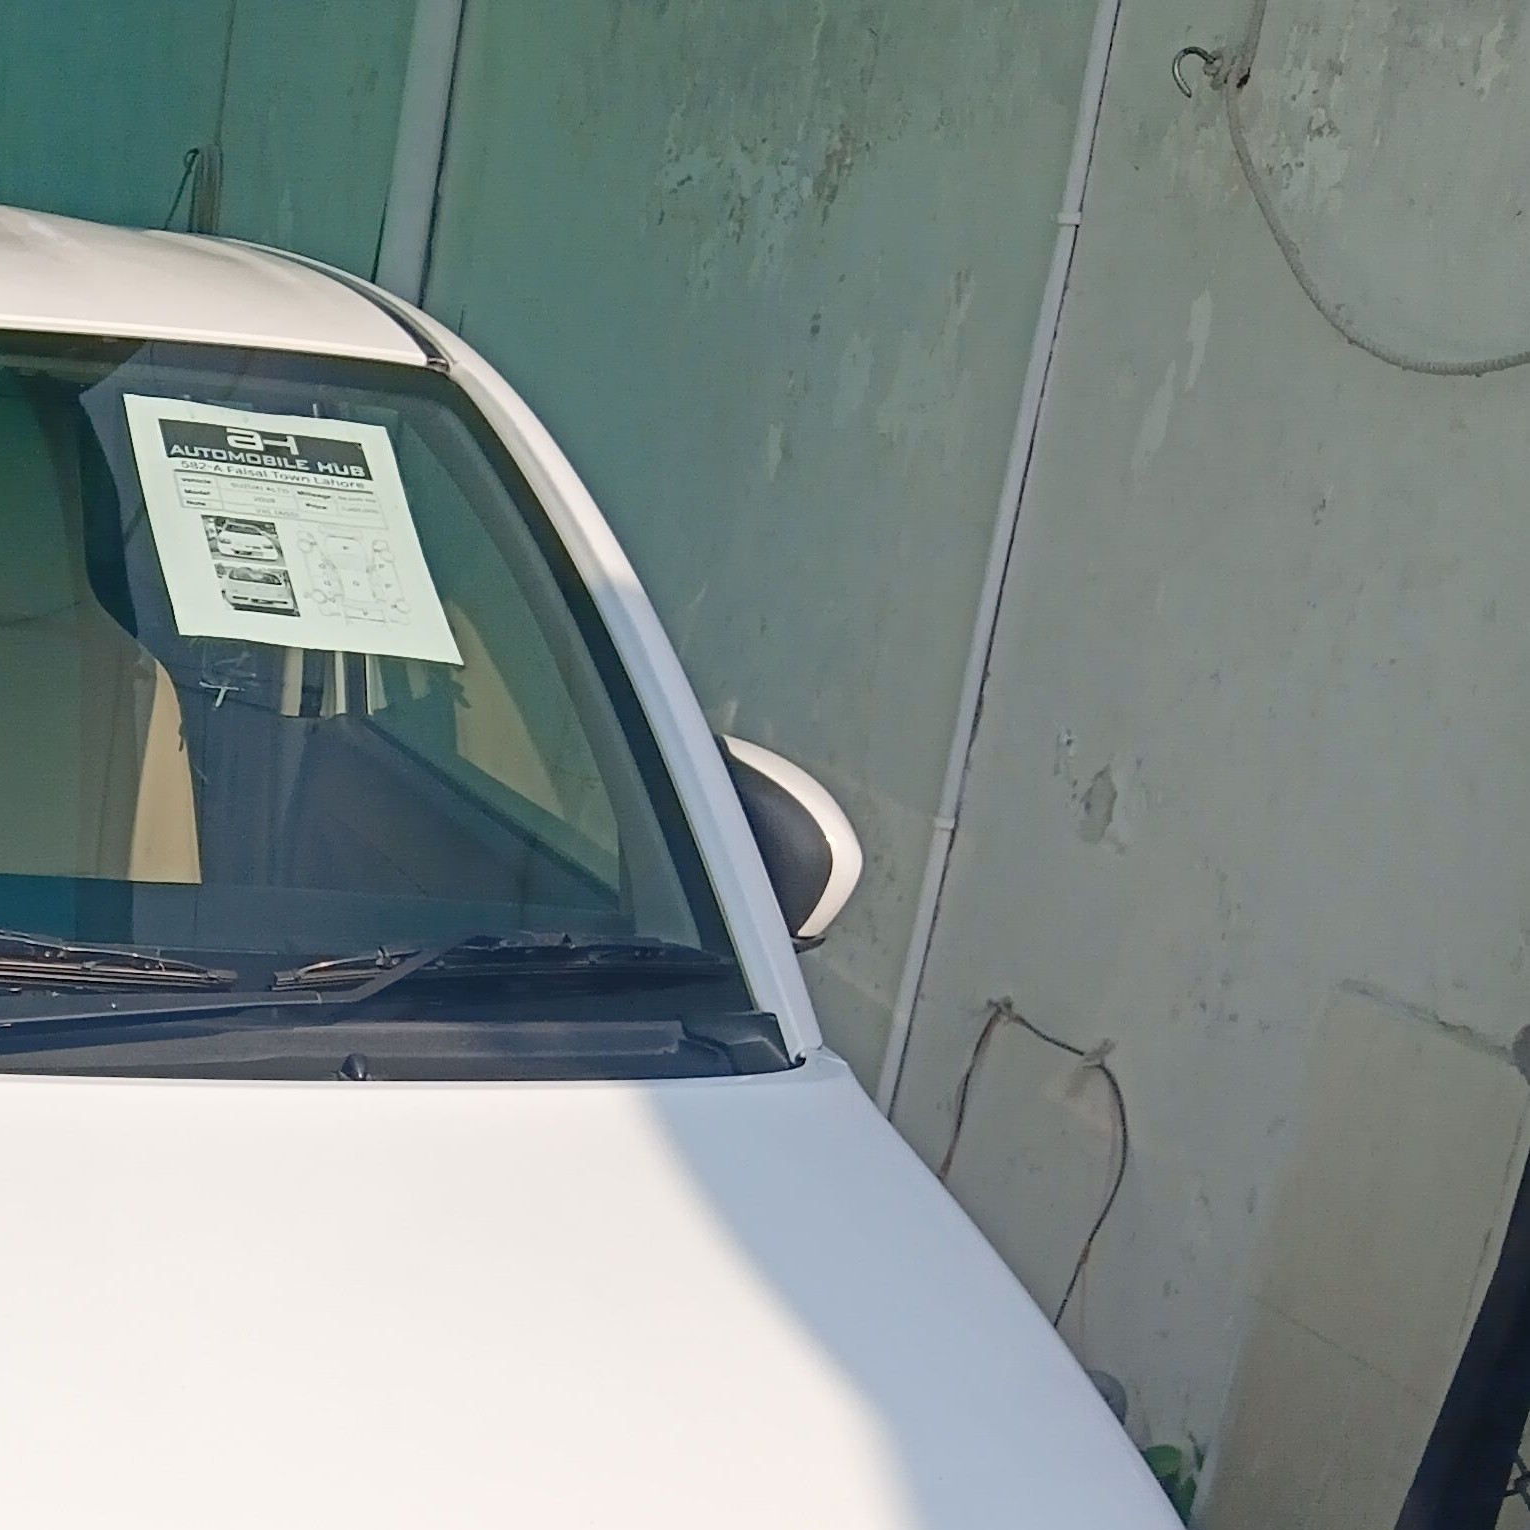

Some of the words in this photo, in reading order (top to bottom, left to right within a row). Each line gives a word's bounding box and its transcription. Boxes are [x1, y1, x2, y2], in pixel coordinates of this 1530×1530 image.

[170, 444, 311, 471] AUTOMOBILE
[317, 461, 365, 478] HUB
[227, 466, 268, 479] Faisal
[273, 471, 310, 483] Town
[314, 476, 365, 489] Lahore
